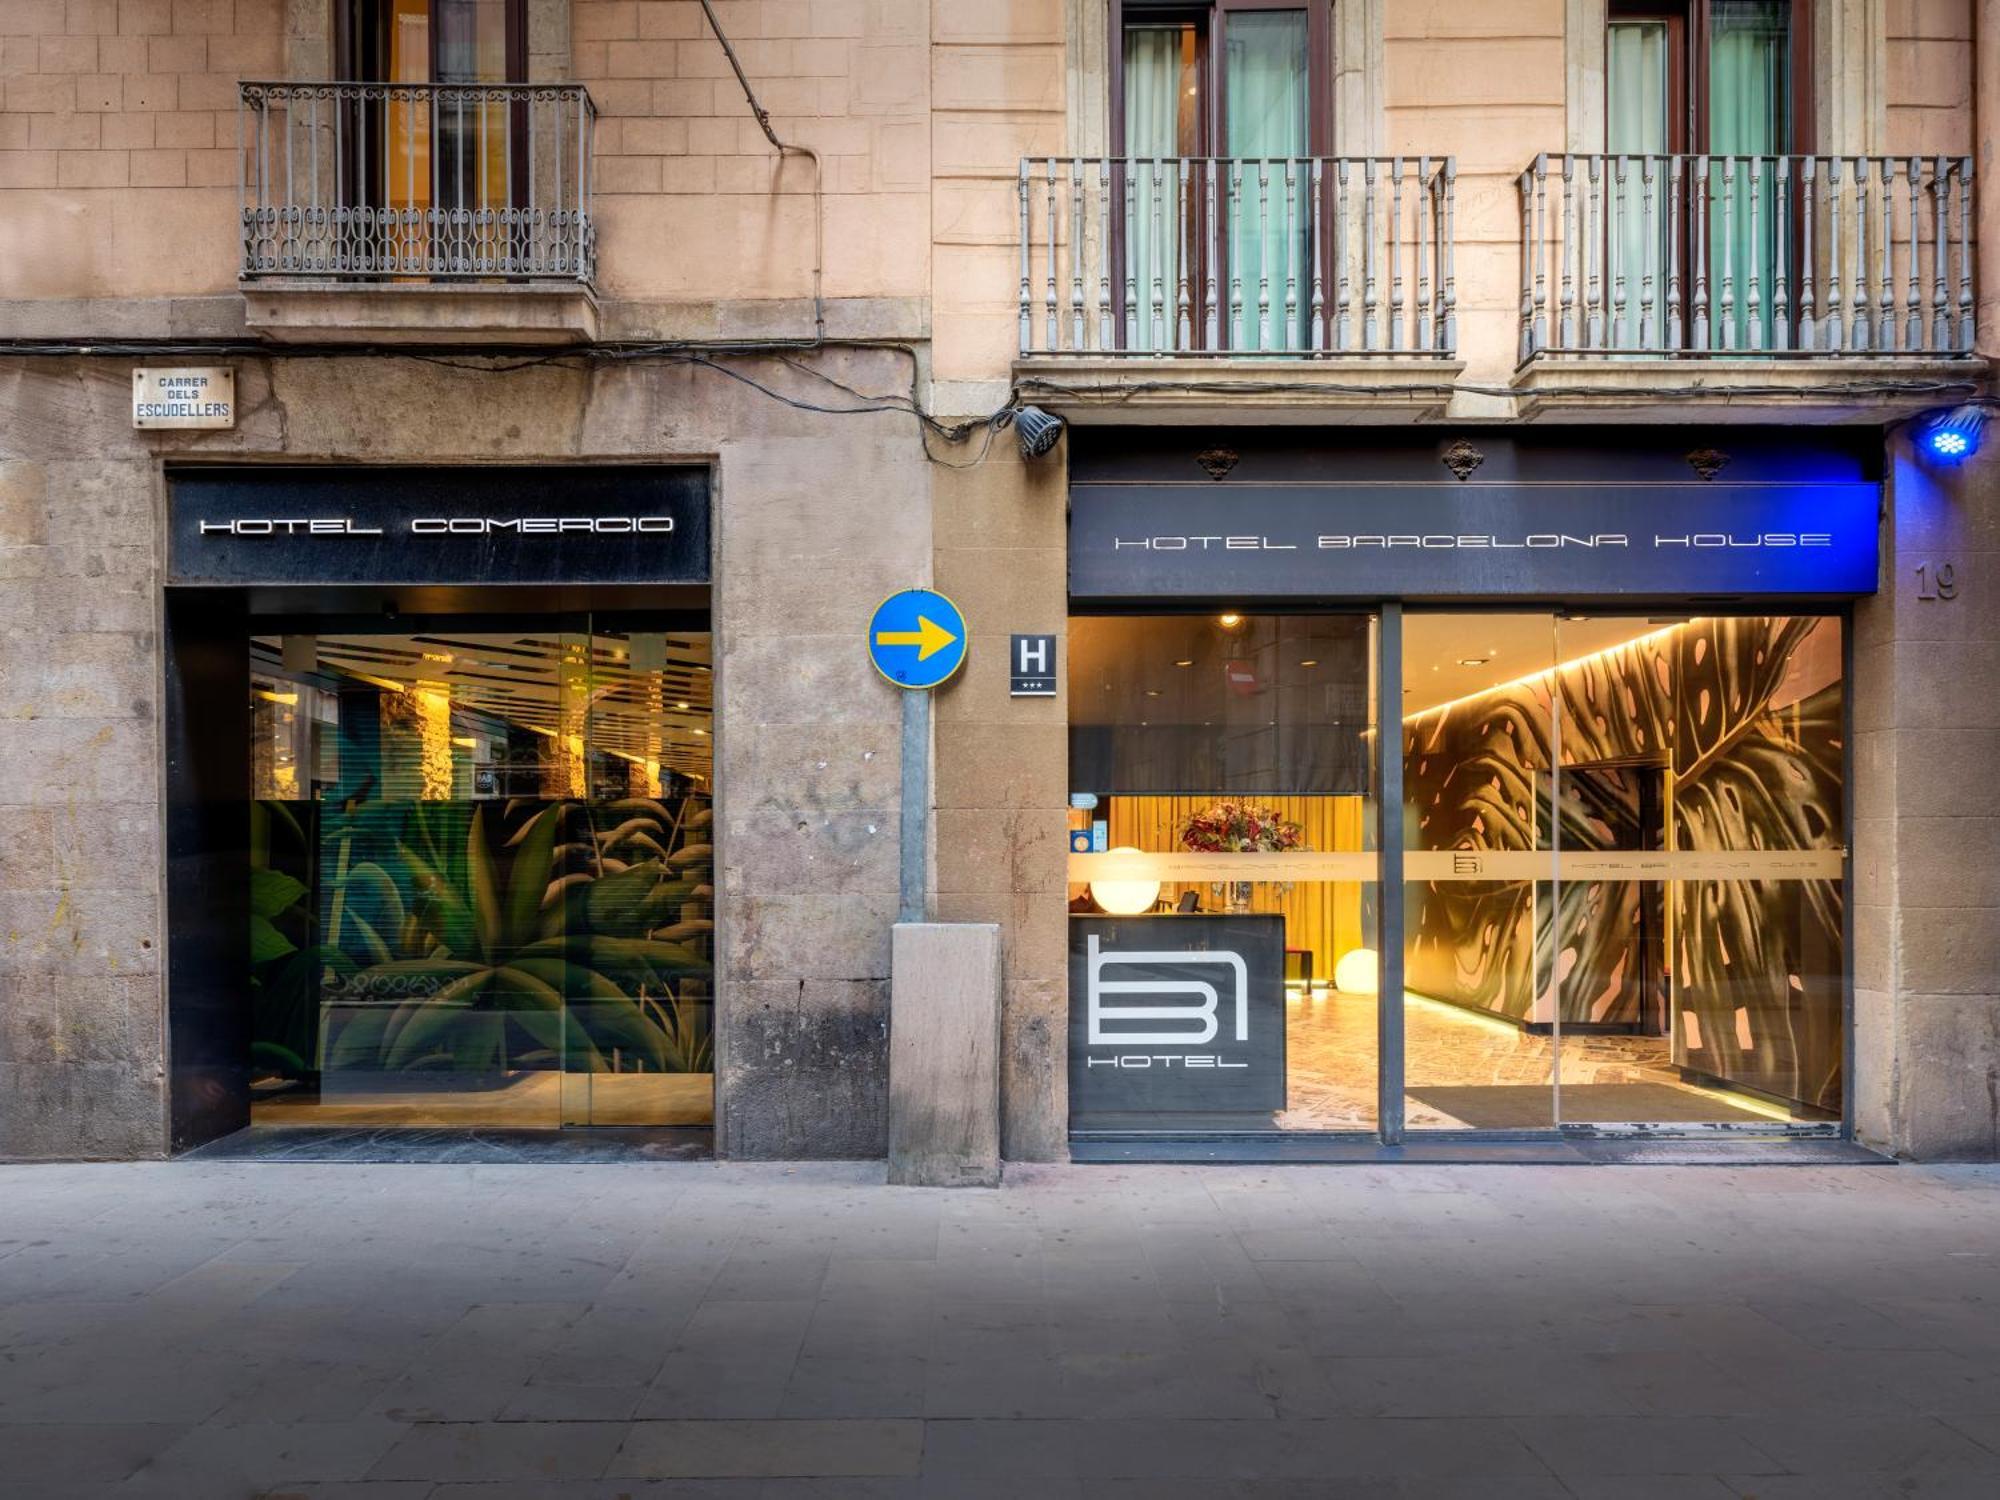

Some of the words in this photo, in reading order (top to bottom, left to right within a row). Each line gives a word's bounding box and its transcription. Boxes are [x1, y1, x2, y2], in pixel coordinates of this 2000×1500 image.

[158, 377, 209, 388] CARRER
[167, 389, 200, 400] DELS
[136, 403, 230, 417] ESCUDELLERS
[200, 519, 383, 535] HOTEL
[411, 517, 674, 533] COMERCIO
[1114, 536, 1297, 550] HOTEL
[1317, 534, 1628, 549] BARCELONA
[1655, 533, 1832, 548] HOUSE
[1914, 560, 1960, 601] 19
[1019, 639, 1047, 673] H
[1087, 1055, 1249, 1068] HOTEL
